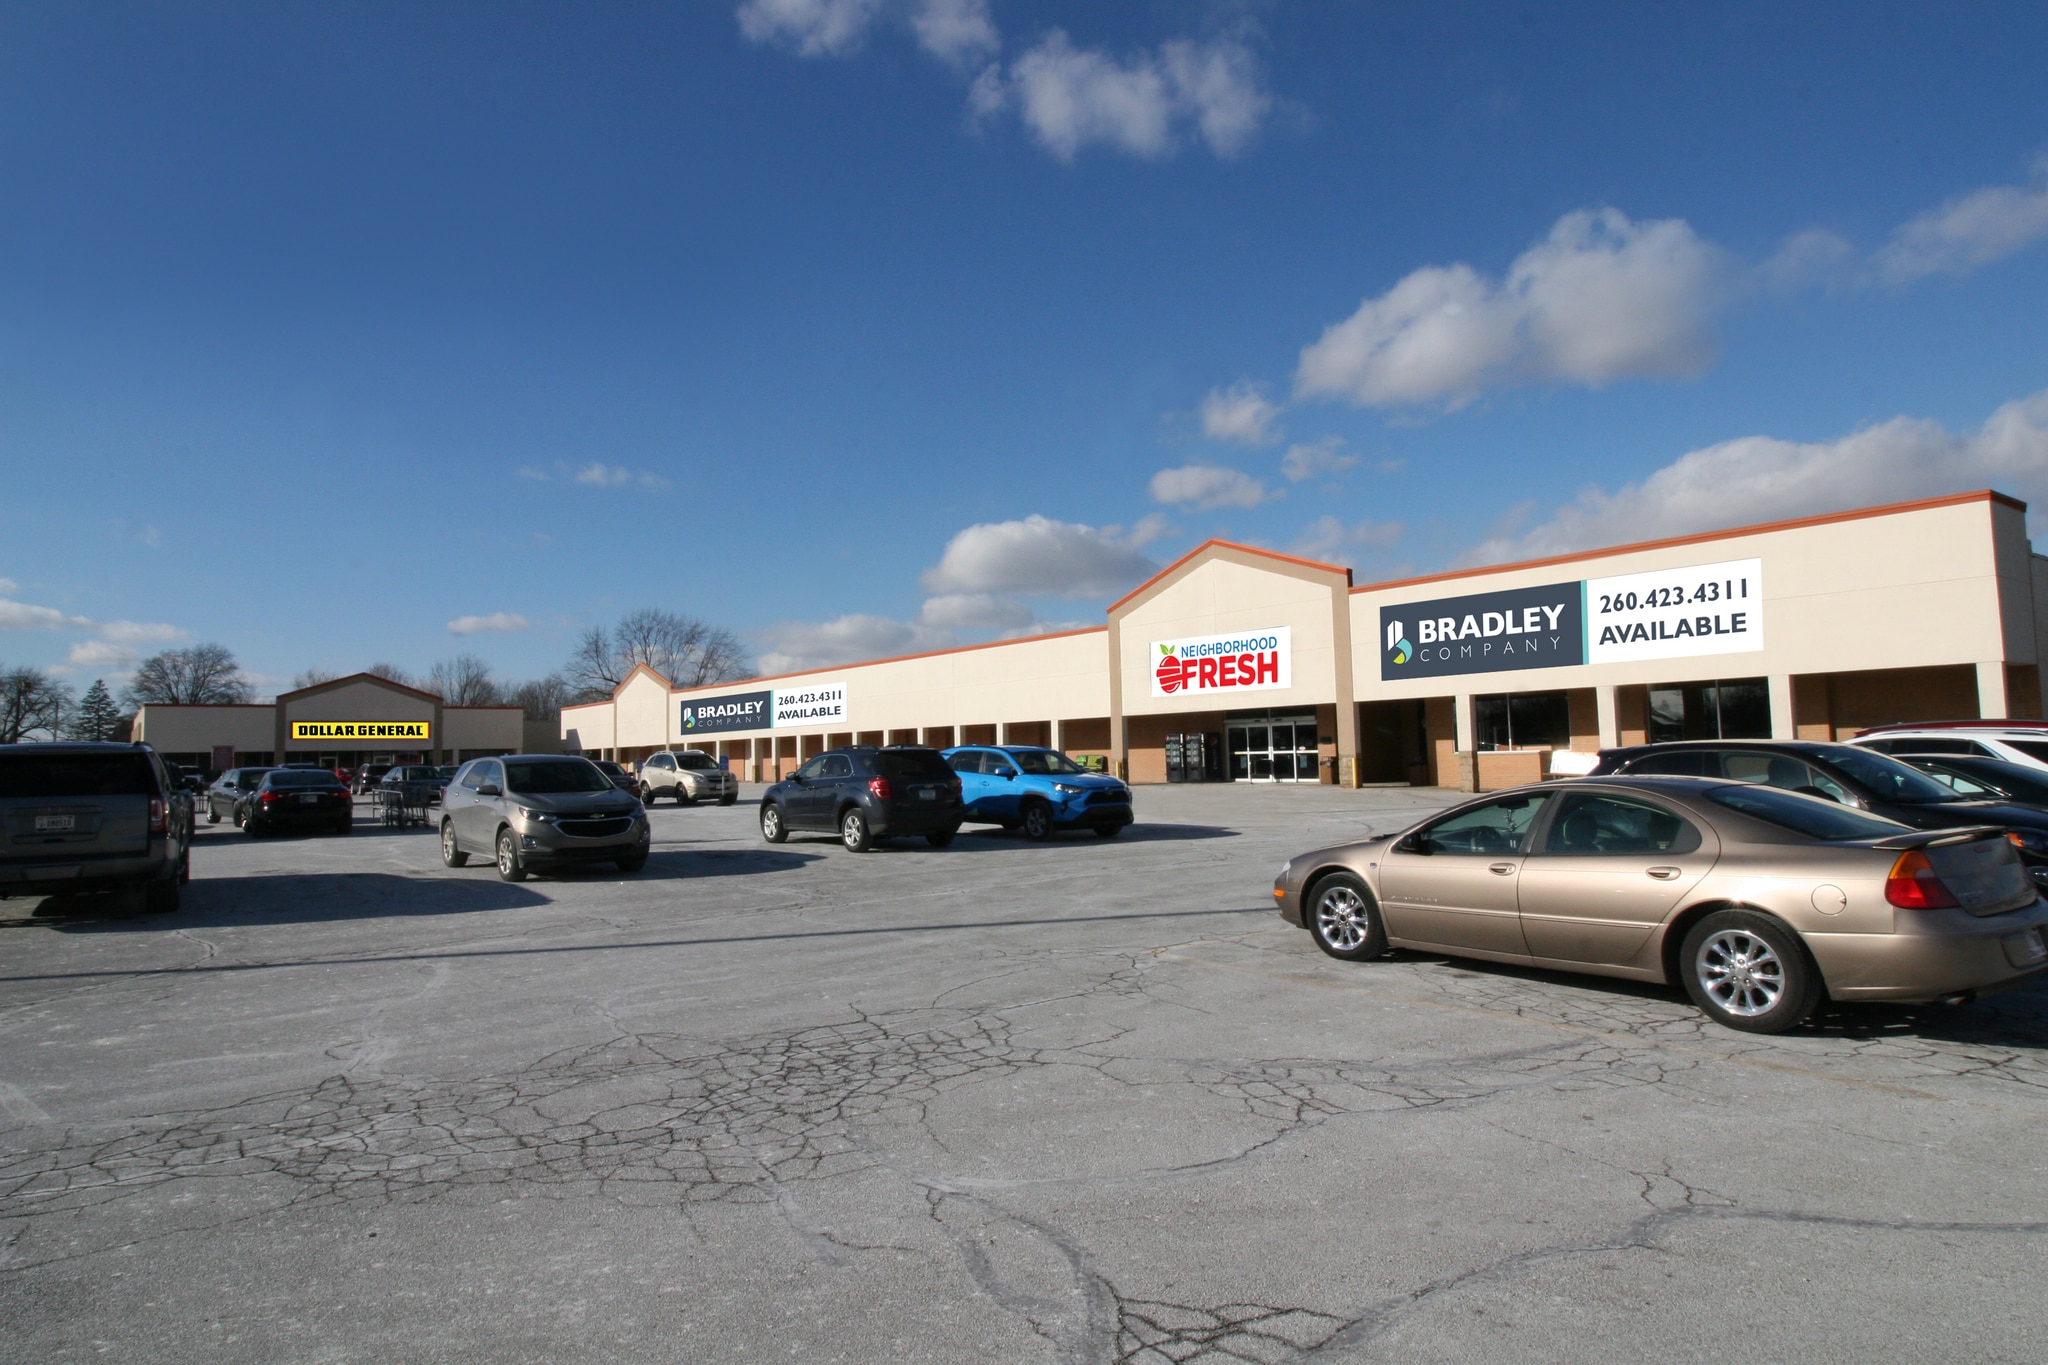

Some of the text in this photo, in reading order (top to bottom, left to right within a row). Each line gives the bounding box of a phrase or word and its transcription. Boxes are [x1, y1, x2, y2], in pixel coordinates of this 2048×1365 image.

[1600, 578, 1747, 614] 260.423.4311
[1419, 604, 1566, 644] BRADLEY
[1599, 612, 1747, 645] AVAILABLE
[1181, 636, 1278, 658] NEIGHBORHOOD
[1420, 636, 1561, 662] COMPANY
[1181, 651, 1278, 690] FRESH
[778, 690, 842, 706] 260.423.4311
[698, 701, 764, 719] BRADLEY
[777, 705, 841, 720] AVAILABLE
[298, 725, 423, 736] DOLLAR GENERAL
[698, 715, 762, 728] COMPANY
